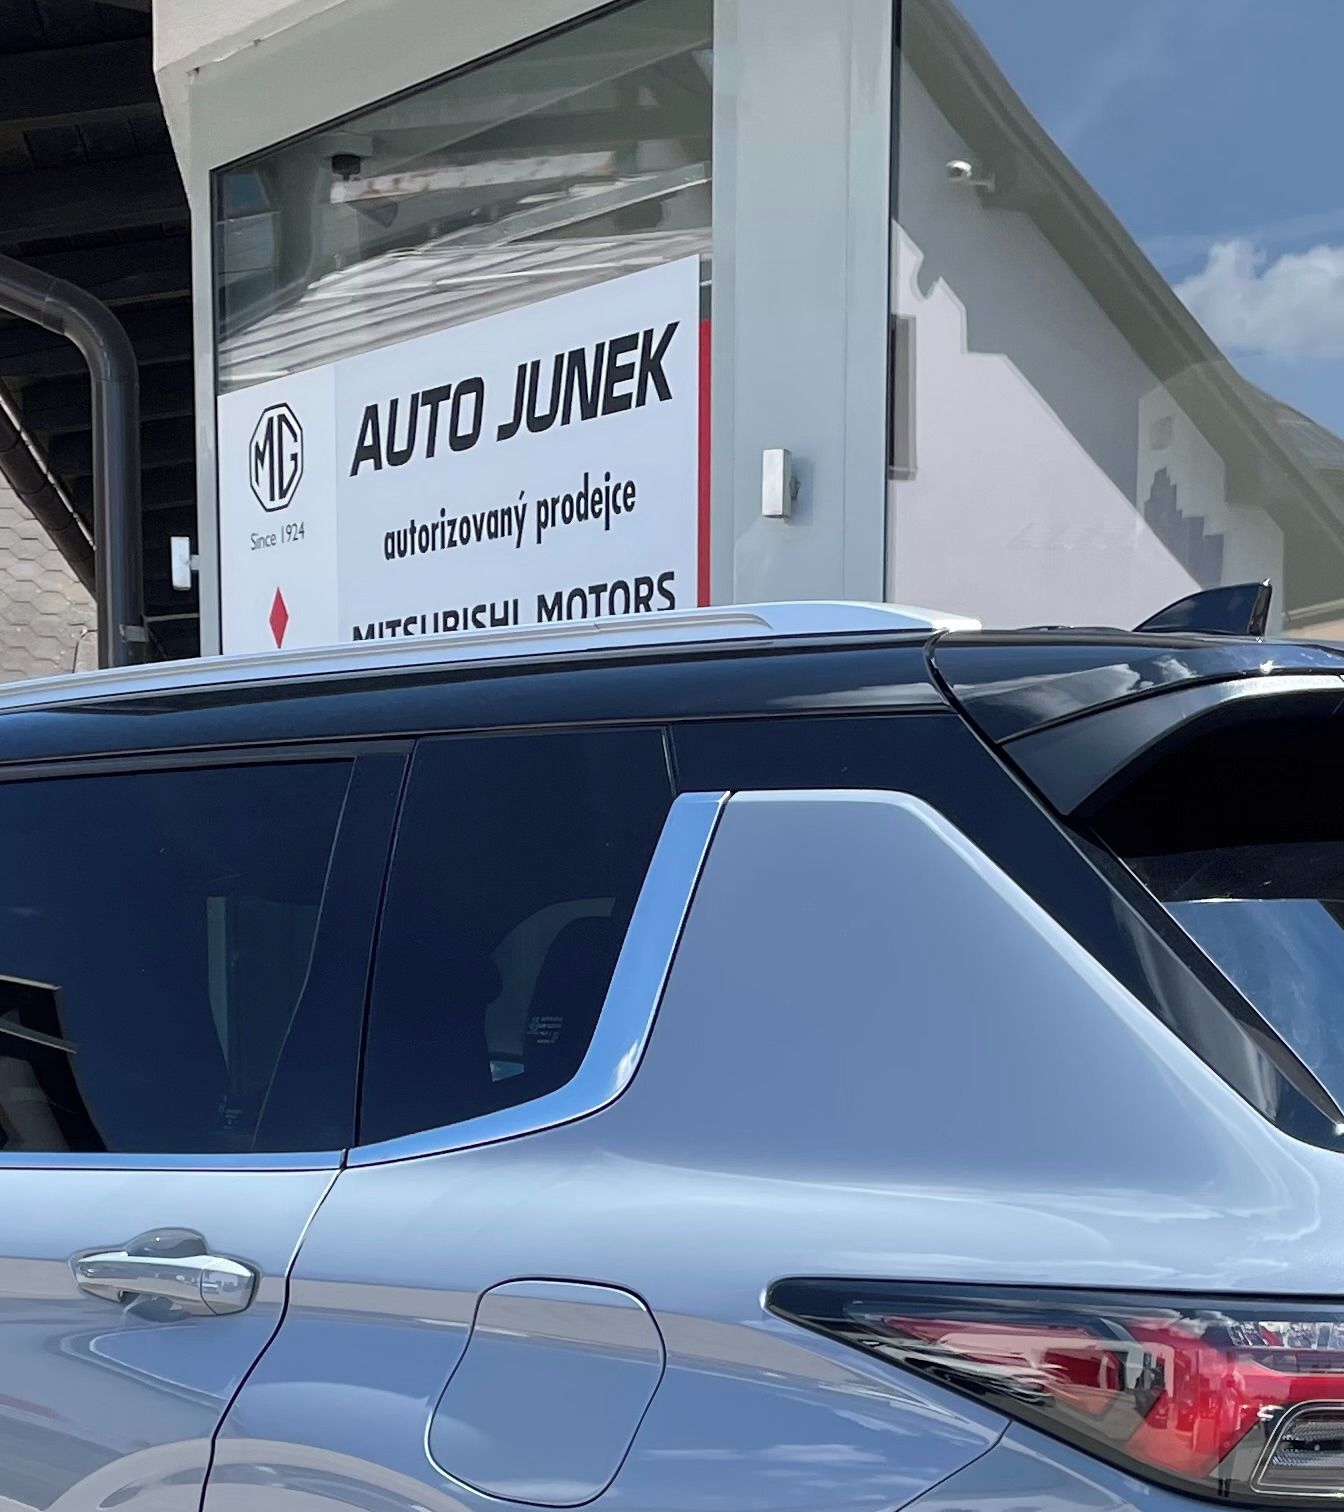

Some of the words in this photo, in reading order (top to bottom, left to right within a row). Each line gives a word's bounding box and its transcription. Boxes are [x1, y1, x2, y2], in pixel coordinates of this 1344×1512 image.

[349, 374, 485, 478] AUTO
[495, 319, 681, 443] JUNEK
[250, 532, 277, 551] Since
[281, 521, 305, 544] 1924
[383, 490, 528, 562] autorizovaný
[536, 472, 637, 544] prodejce
